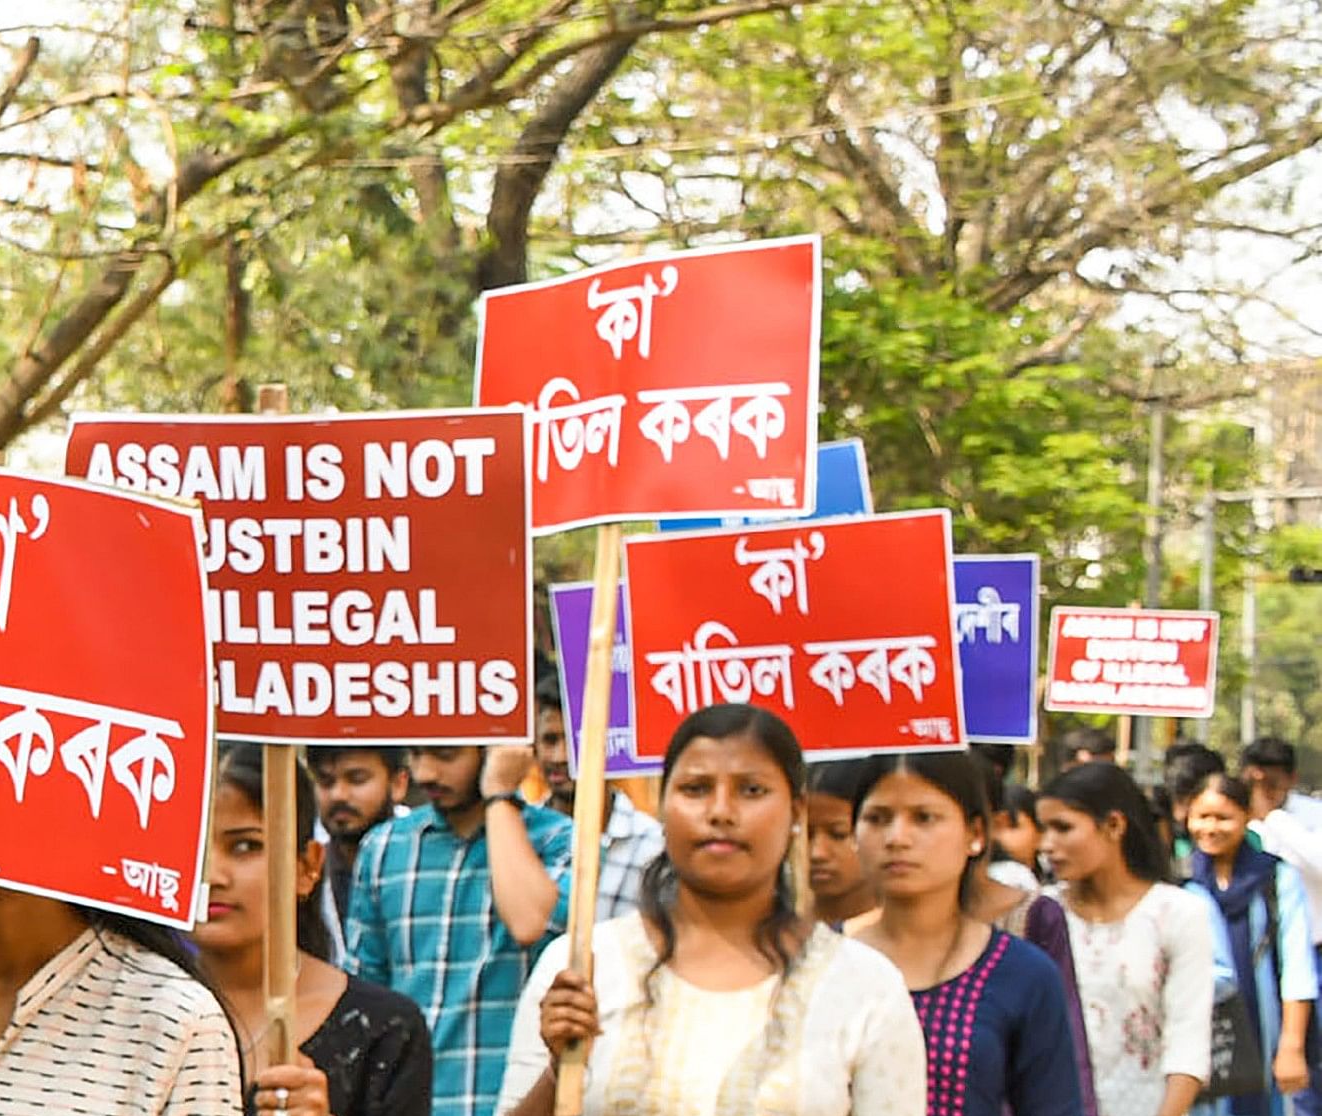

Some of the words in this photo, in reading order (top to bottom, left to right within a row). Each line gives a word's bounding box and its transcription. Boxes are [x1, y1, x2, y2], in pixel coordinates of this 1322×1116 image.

[87, 442, 267, 501] ASSAM
[286, 444, 345, 501] IS
[364, 438, 496, 499] NOT
[203, 516, 410, 574] USTBIN
[208, 589, 456, 645] ILLEGAL
[216, 660, 518, 717] LADESHIS
[645, 621, 794, 713] বাতিল
